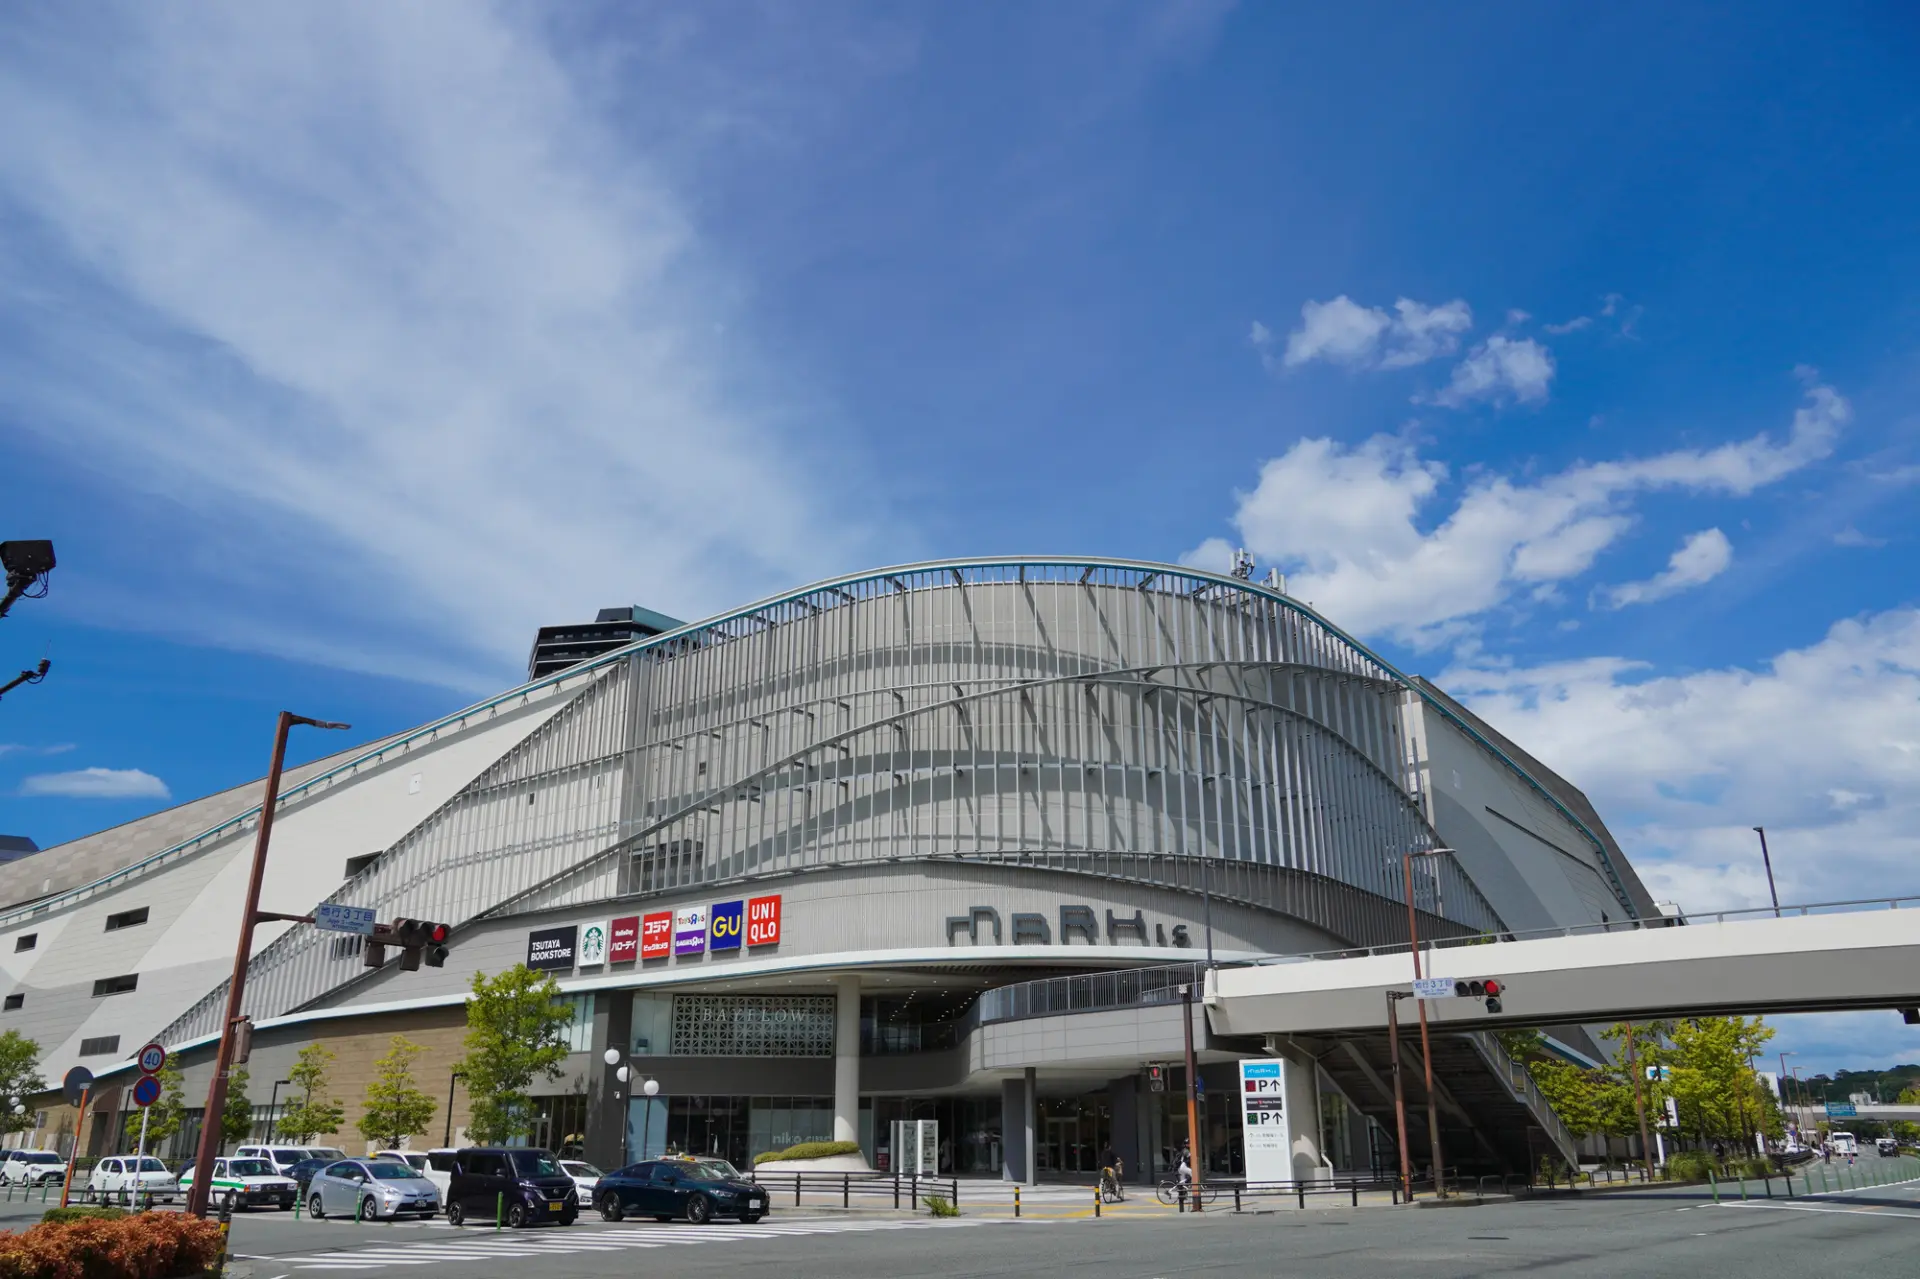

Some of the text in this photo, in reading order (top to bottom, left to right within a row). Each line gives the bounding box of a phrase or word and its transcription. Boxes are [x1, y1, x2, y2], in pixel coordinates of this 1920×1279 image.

[751, 902, 775, 920] UNI
[644, 919, 670, 934] コジマ
[712, 915, 741, 937] GU
[750, 921, 777, 942] QLO
[532, 938, 561, 951] TSUTAYA
[530, 948, 572, 962] BOOKSTORE
[703, 1008, 808, 1022] BAYFLOW
[144, 1052, 161, 1066] 40
[1259, 1080, 1267, 1092] P
[1261, 1112, 1270, 1125] P
[772, 1132, 802, 1145] niko
